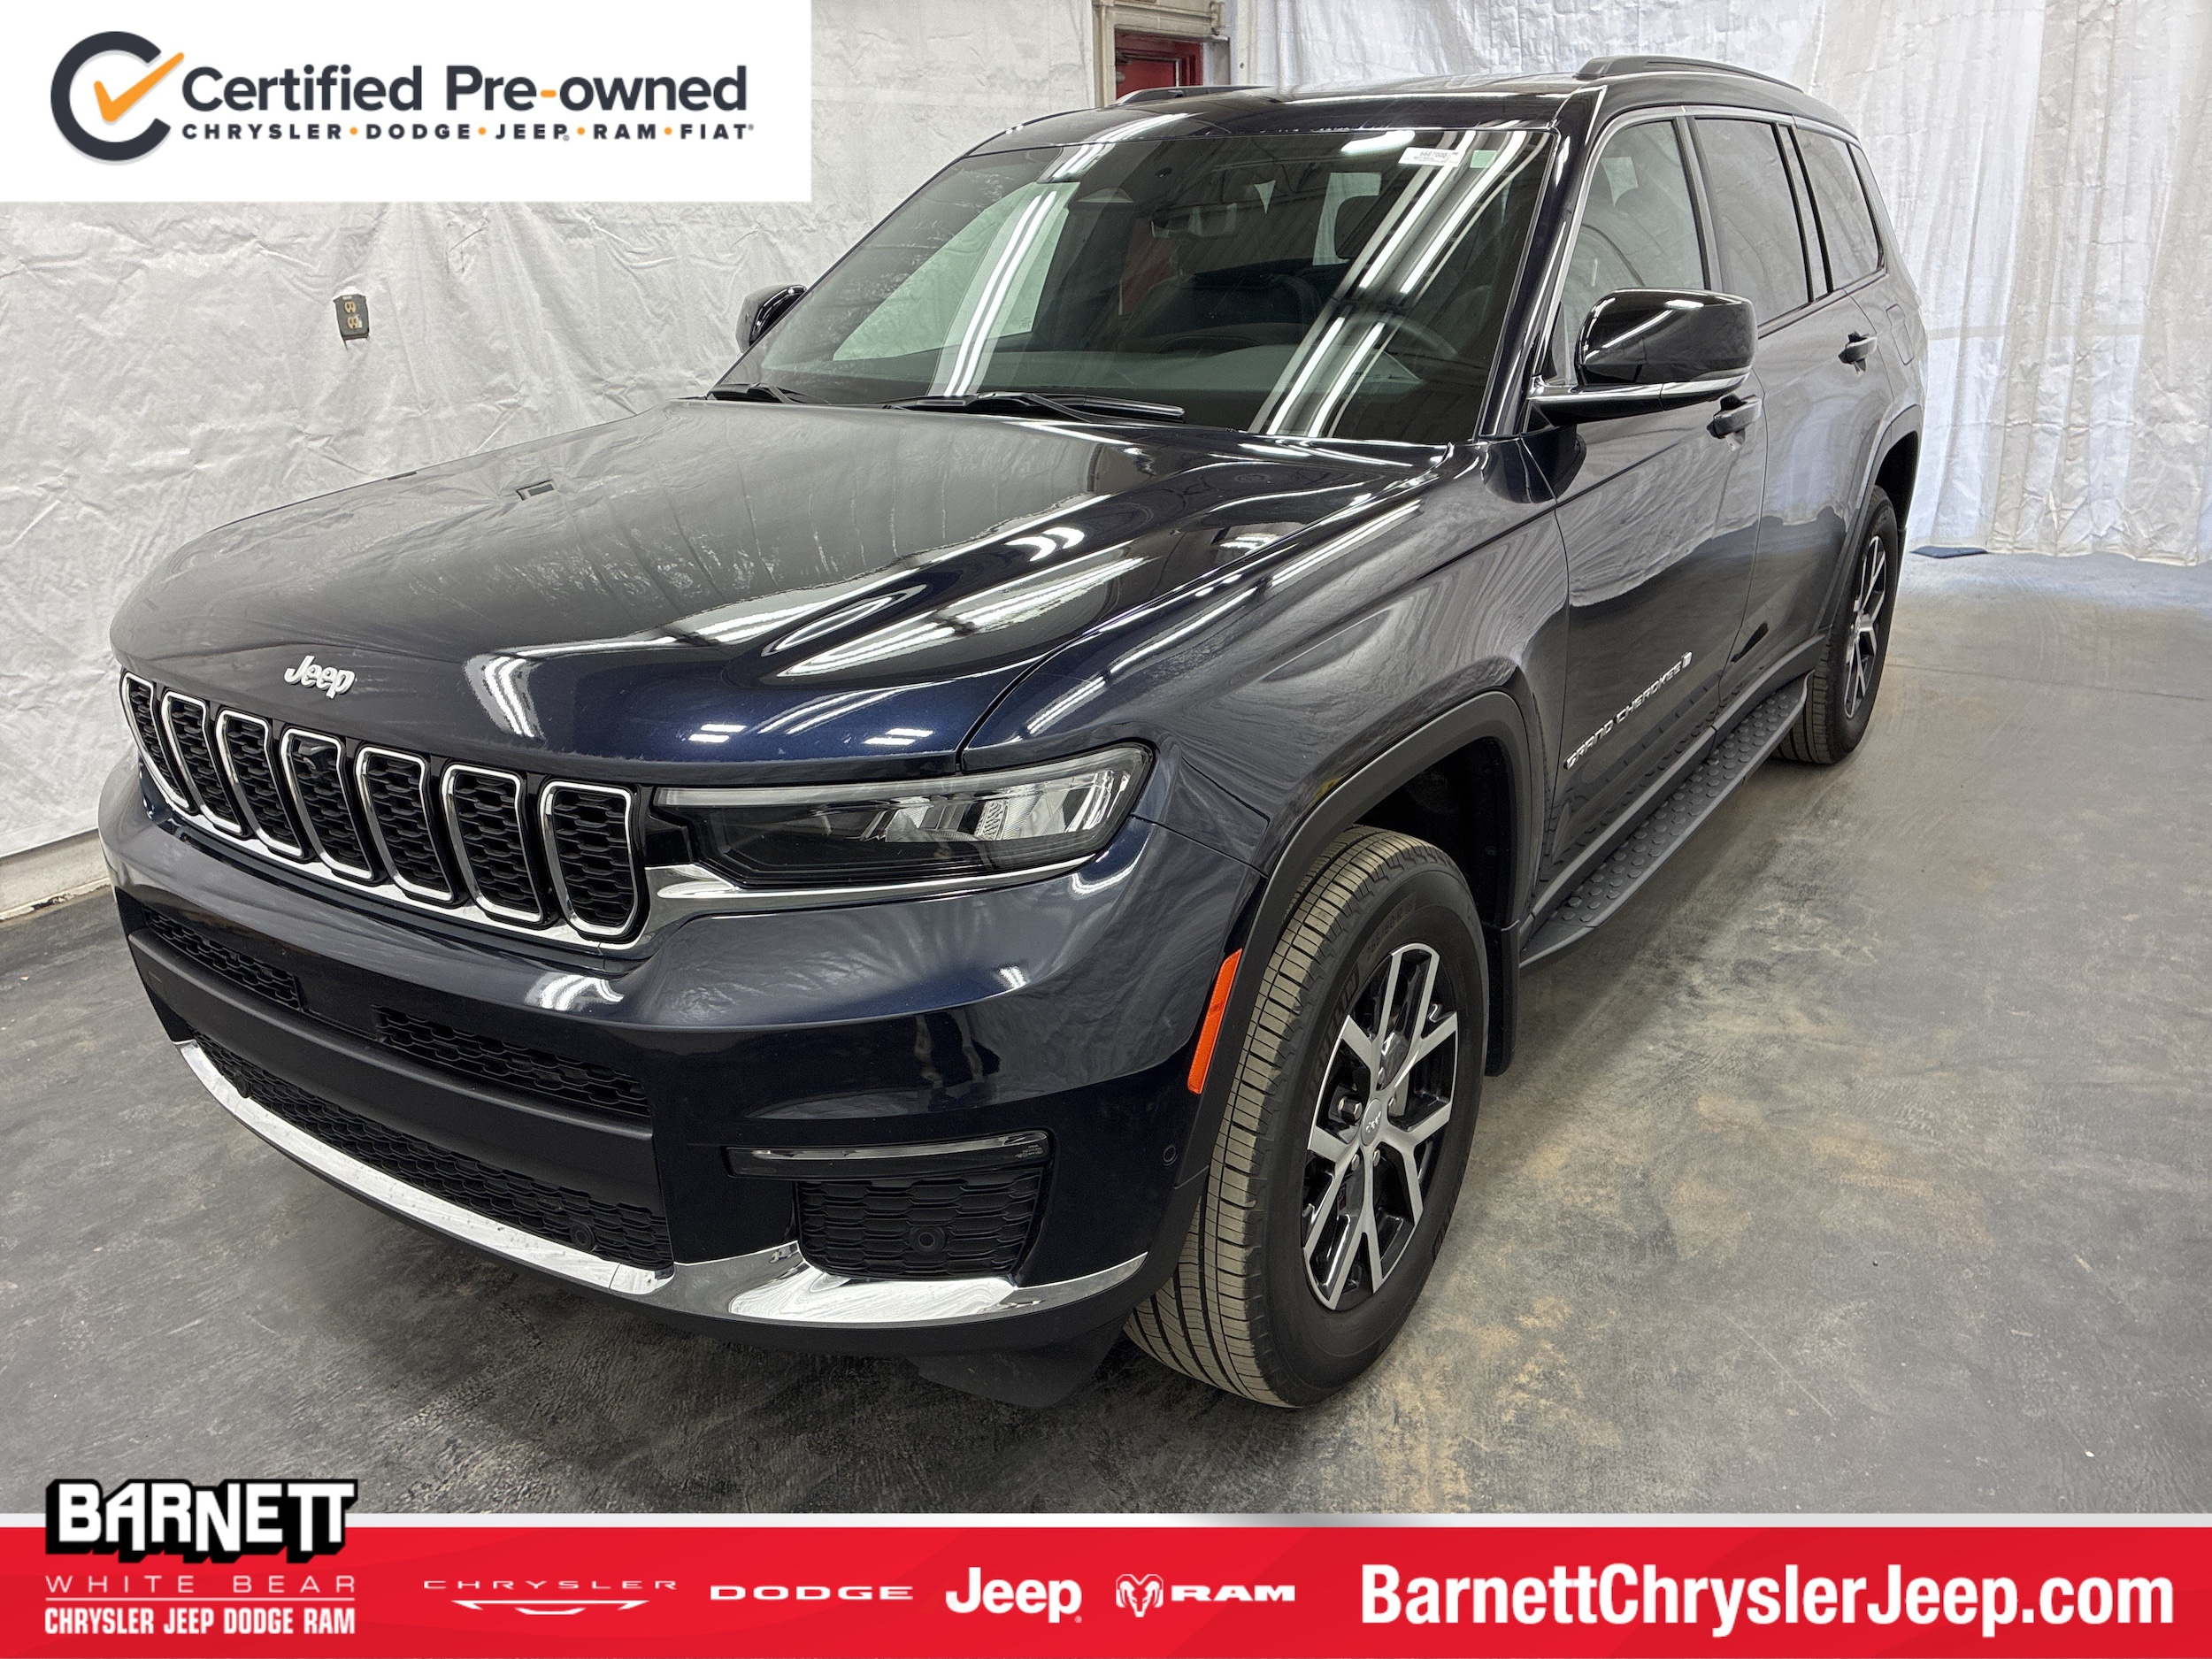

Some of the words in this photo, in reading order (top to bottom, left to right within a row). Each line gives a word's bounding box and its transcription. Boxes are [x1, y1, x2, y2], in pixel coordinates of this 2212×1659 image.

[284, 655, 356, 699] Jeep
[1564, 718, 1614, 770] GRAND
[1615, 660, 1682, 724] CHEROKEE
